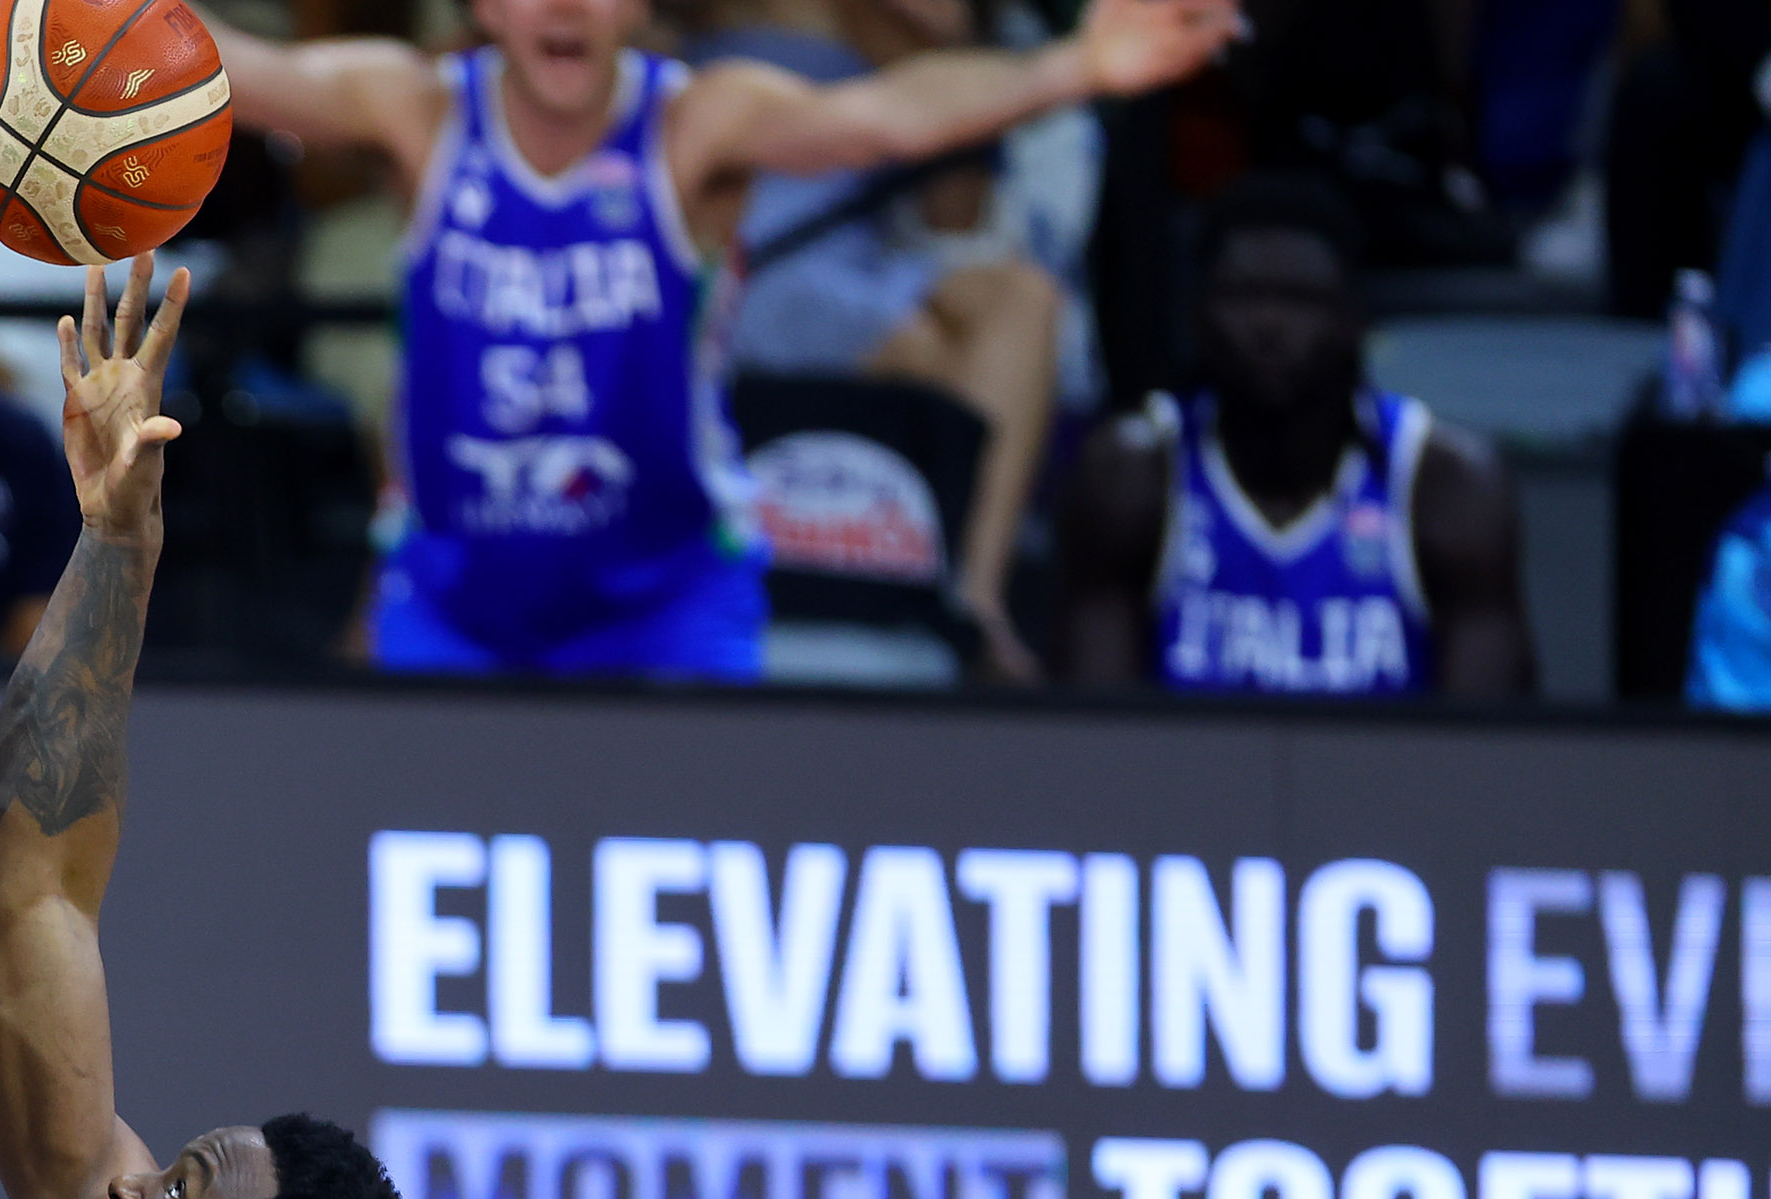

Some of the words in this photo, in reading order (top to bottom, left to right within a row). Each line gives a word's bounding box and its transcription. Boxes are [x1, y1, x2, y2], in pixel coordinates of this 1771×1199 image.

[434, 230, 664, 336] ITALIA
[1166, 590, 1411, 693] ITALIA
[368, 829, 1436, 1101] ELEVATING
